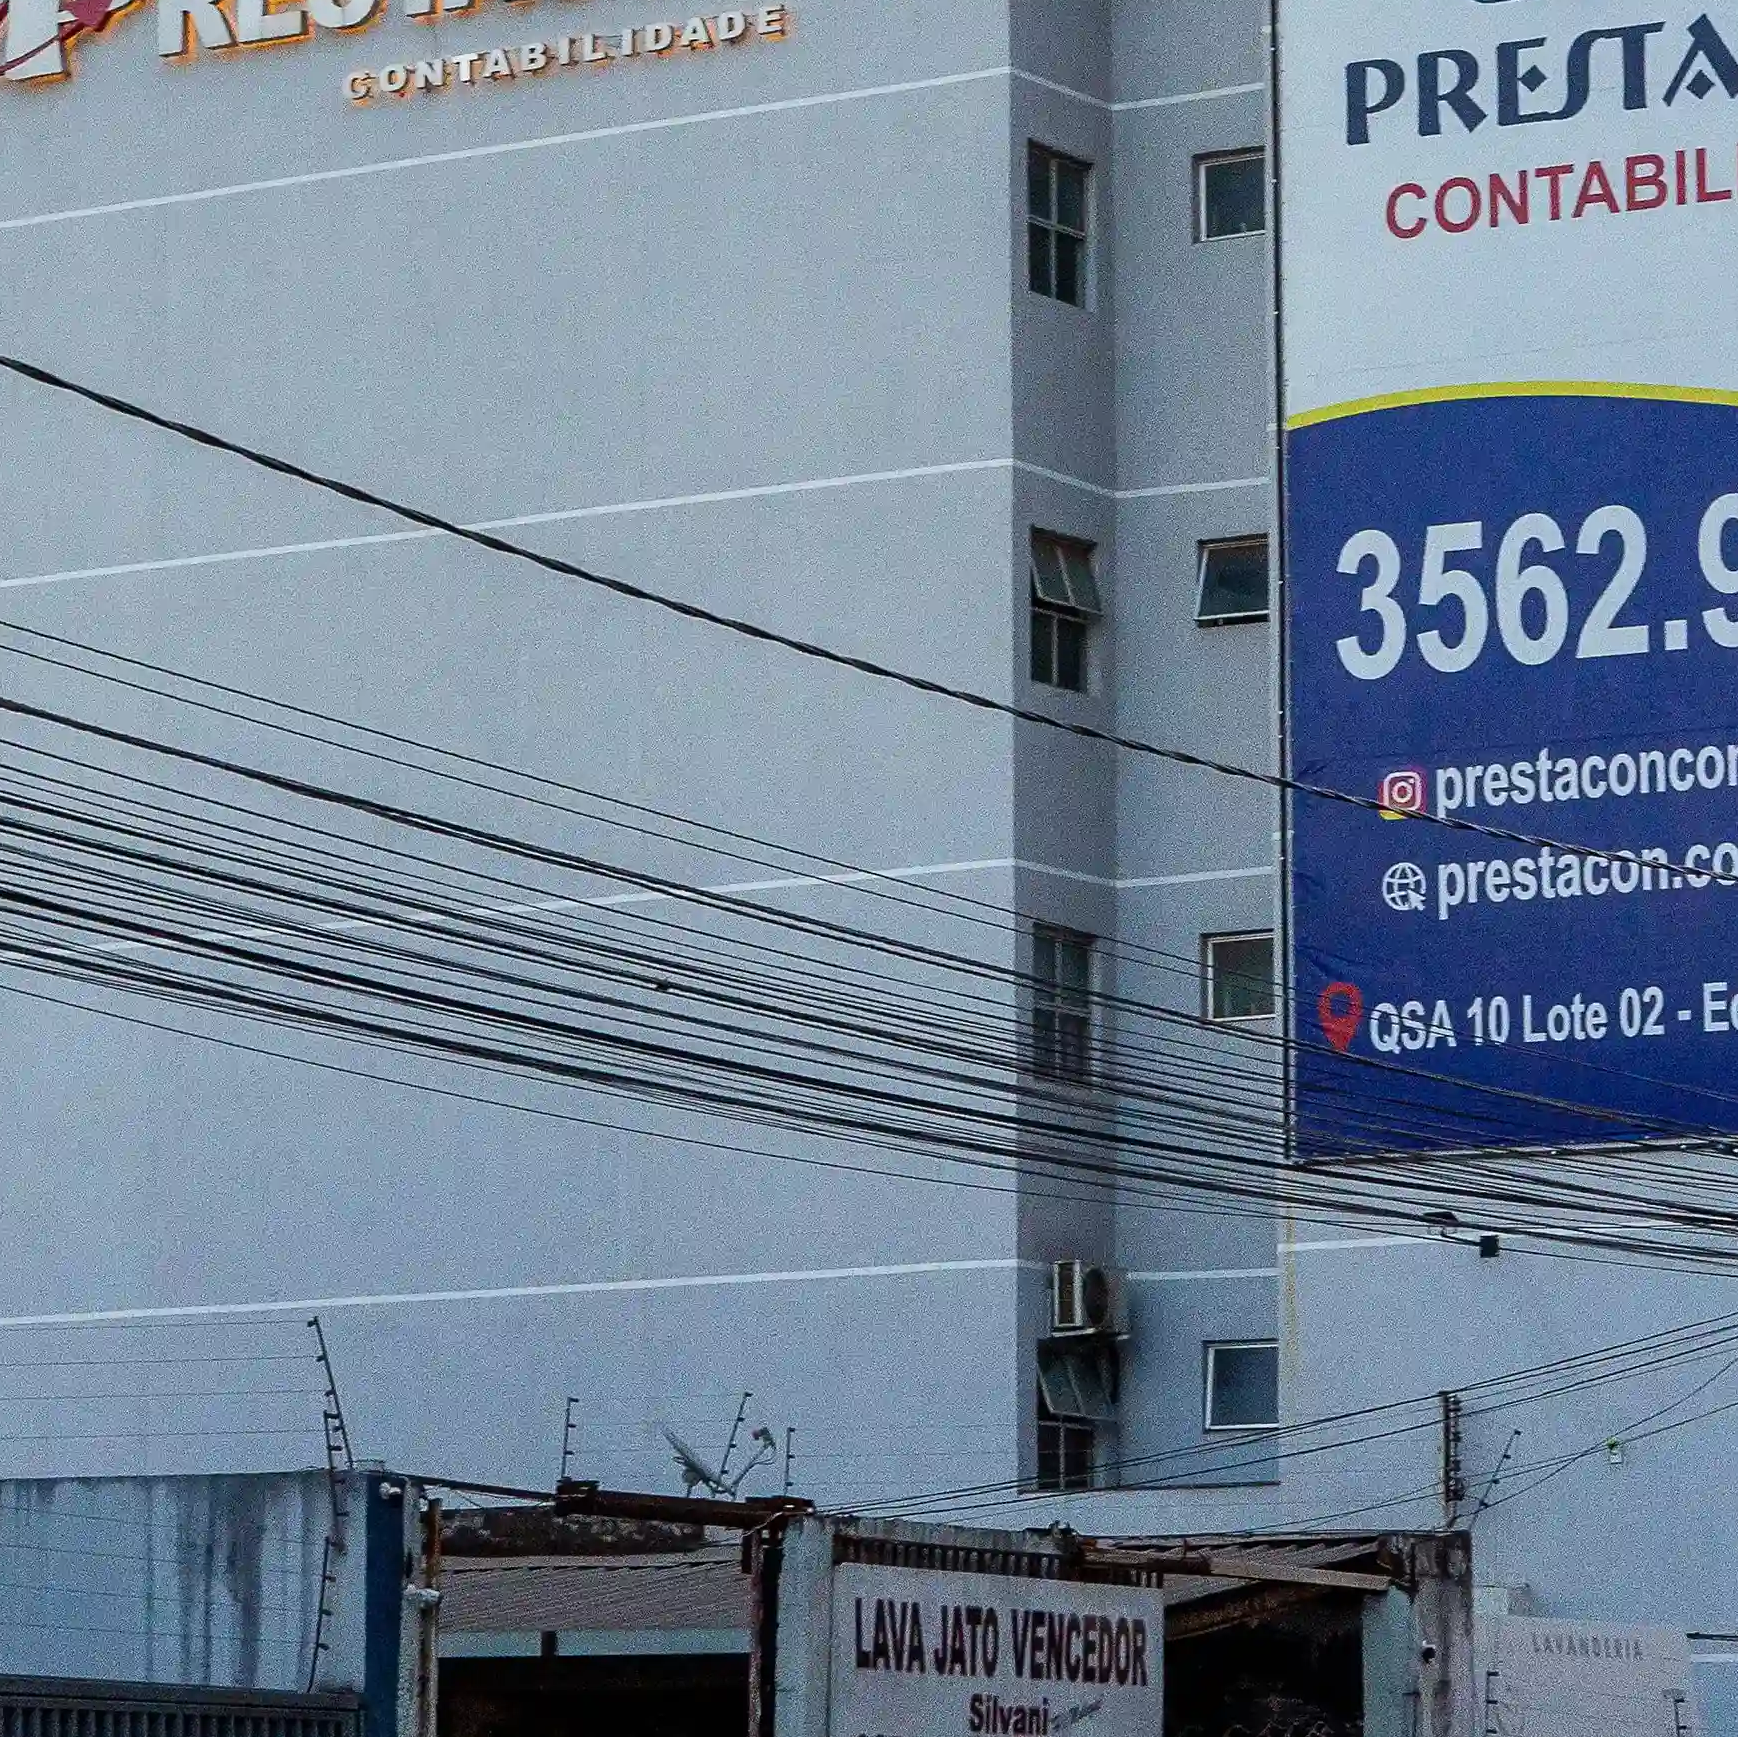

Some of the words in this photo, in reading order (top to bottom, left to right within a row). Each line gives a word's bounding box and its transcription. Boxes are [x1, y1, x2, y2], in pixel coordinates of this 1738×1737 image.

[342, 3, 788, 100] CONTABILIDADE
[1369, 1000, 1456, 1054] QSA
[1468, 998, 1509, 1046] 10
[1523, 991, 1608, 1044] Lote
[1620, 985, 1665, 1038] 02
[854, 1597, 926, 1674] LAVA
[934, 1604, 999, 1678] JATO
[1011, 1608, 1148, 1686] VENCEDOR
[1531, 1631, 1644, 1661] LAVANDERIA
[969, 1692, 1051, 1736] Silvani
